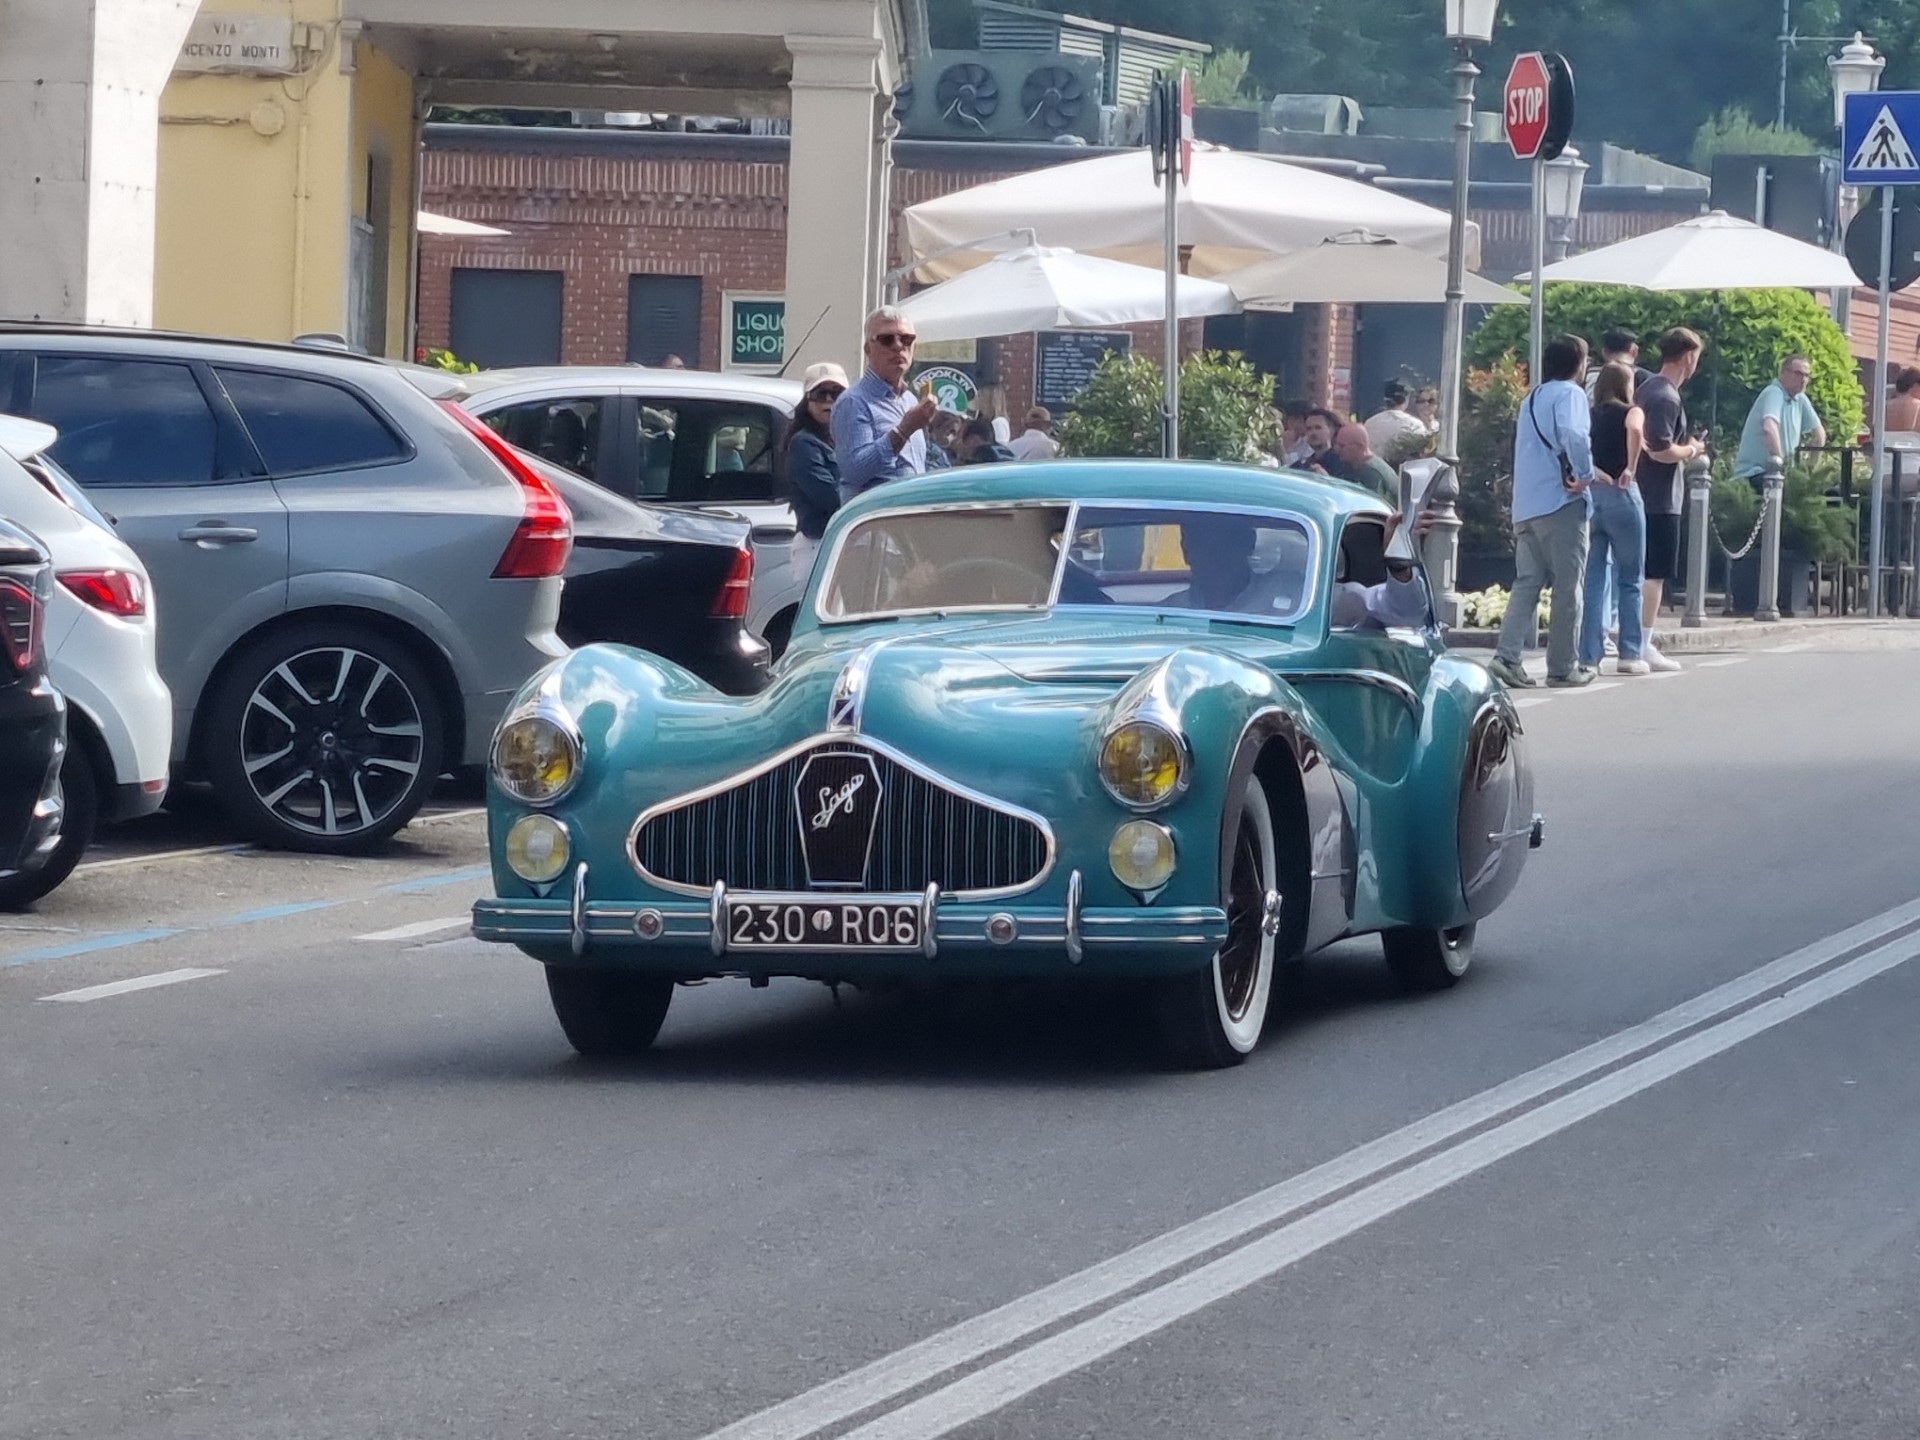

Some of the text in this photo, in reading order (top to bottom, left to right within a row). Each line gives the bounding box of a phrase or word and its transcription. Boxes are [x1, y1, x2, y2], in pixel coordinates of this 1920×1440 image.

[214, 23, 236, 35] VIA
[241, 45, 280, 59] MONTI
[1509, 87, 1543, 126] STOP
[737, 313, 785, 331] LIQU
[811, 773, 865, 831] Lago
[733, 904, 805, 943] 230
